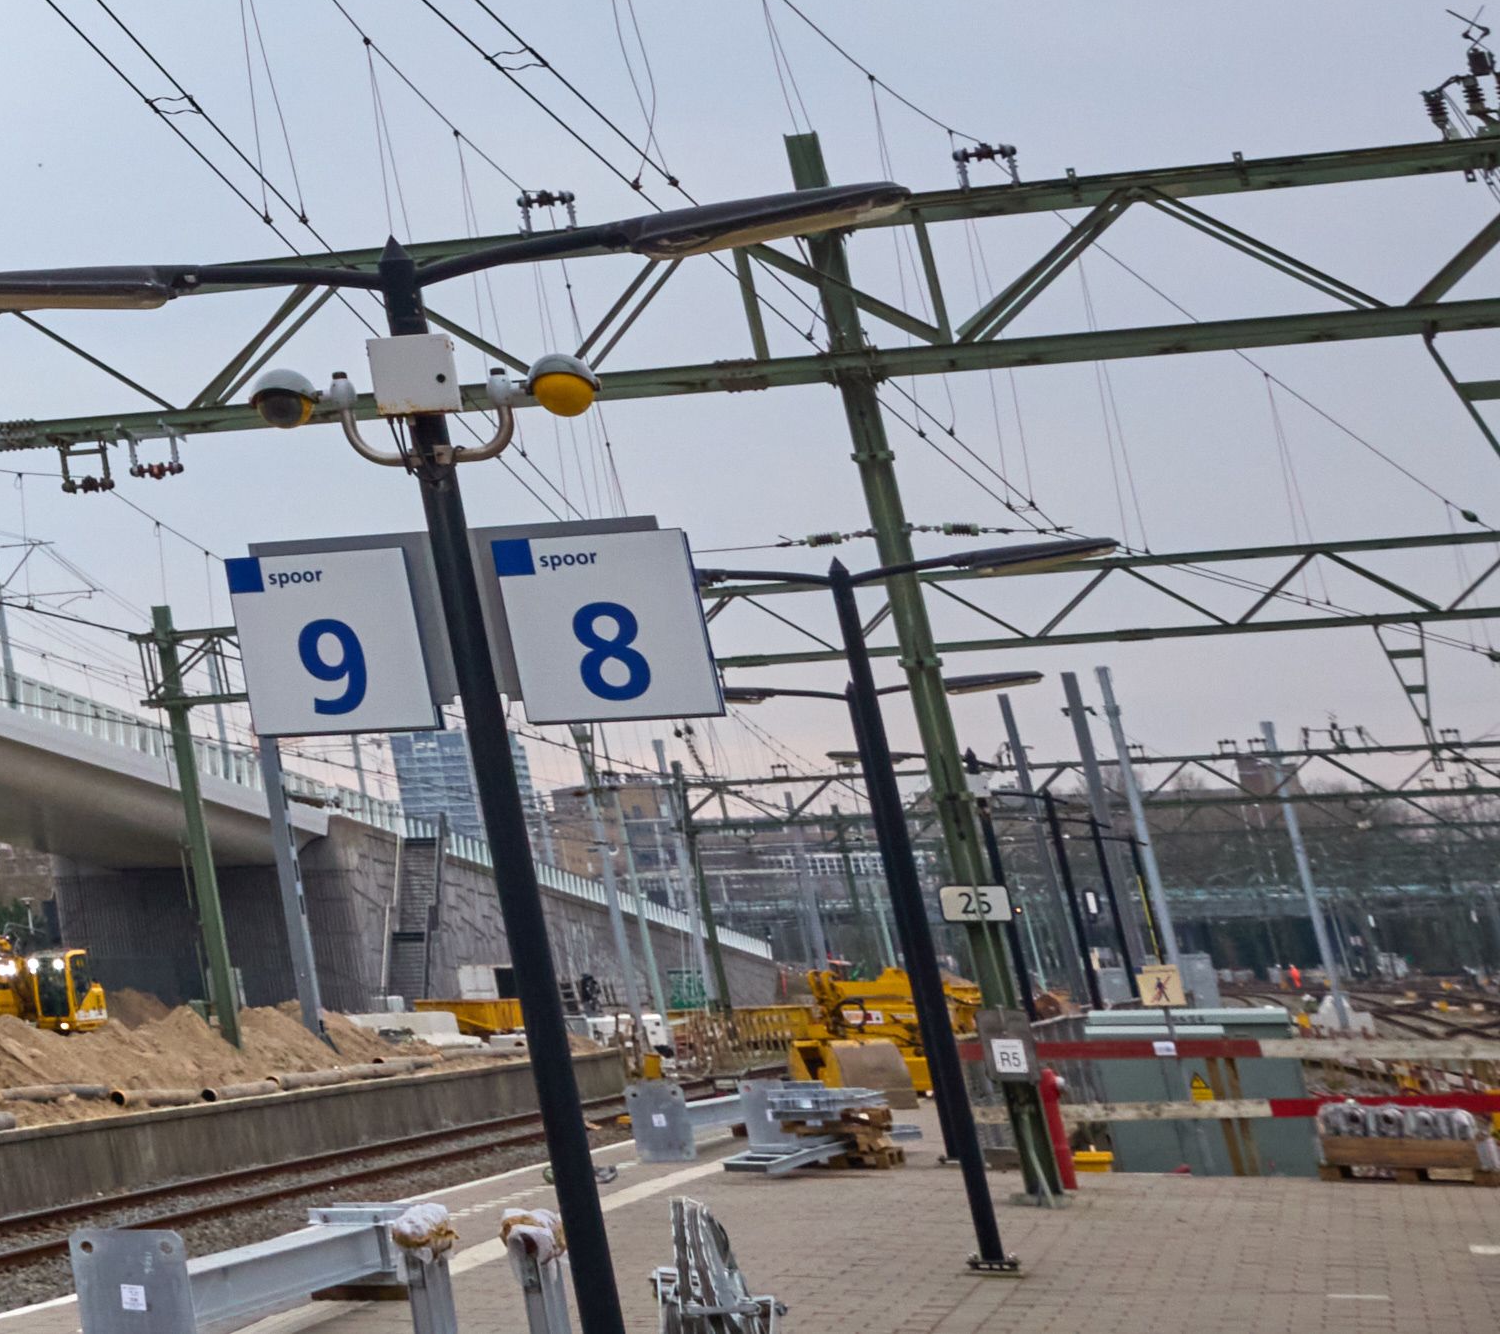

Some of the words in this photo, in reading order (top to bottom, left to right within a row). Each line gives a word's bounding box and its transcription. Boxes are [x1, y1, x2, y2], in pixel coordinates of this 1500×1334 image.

[540, 549, 597, 572] spoor
[268, 566, 323, 588] spoor
[572, 602, 652, 702] 8
[298, 619, 368, 716] 9
[999, 1051, 1021, 1068] R5
